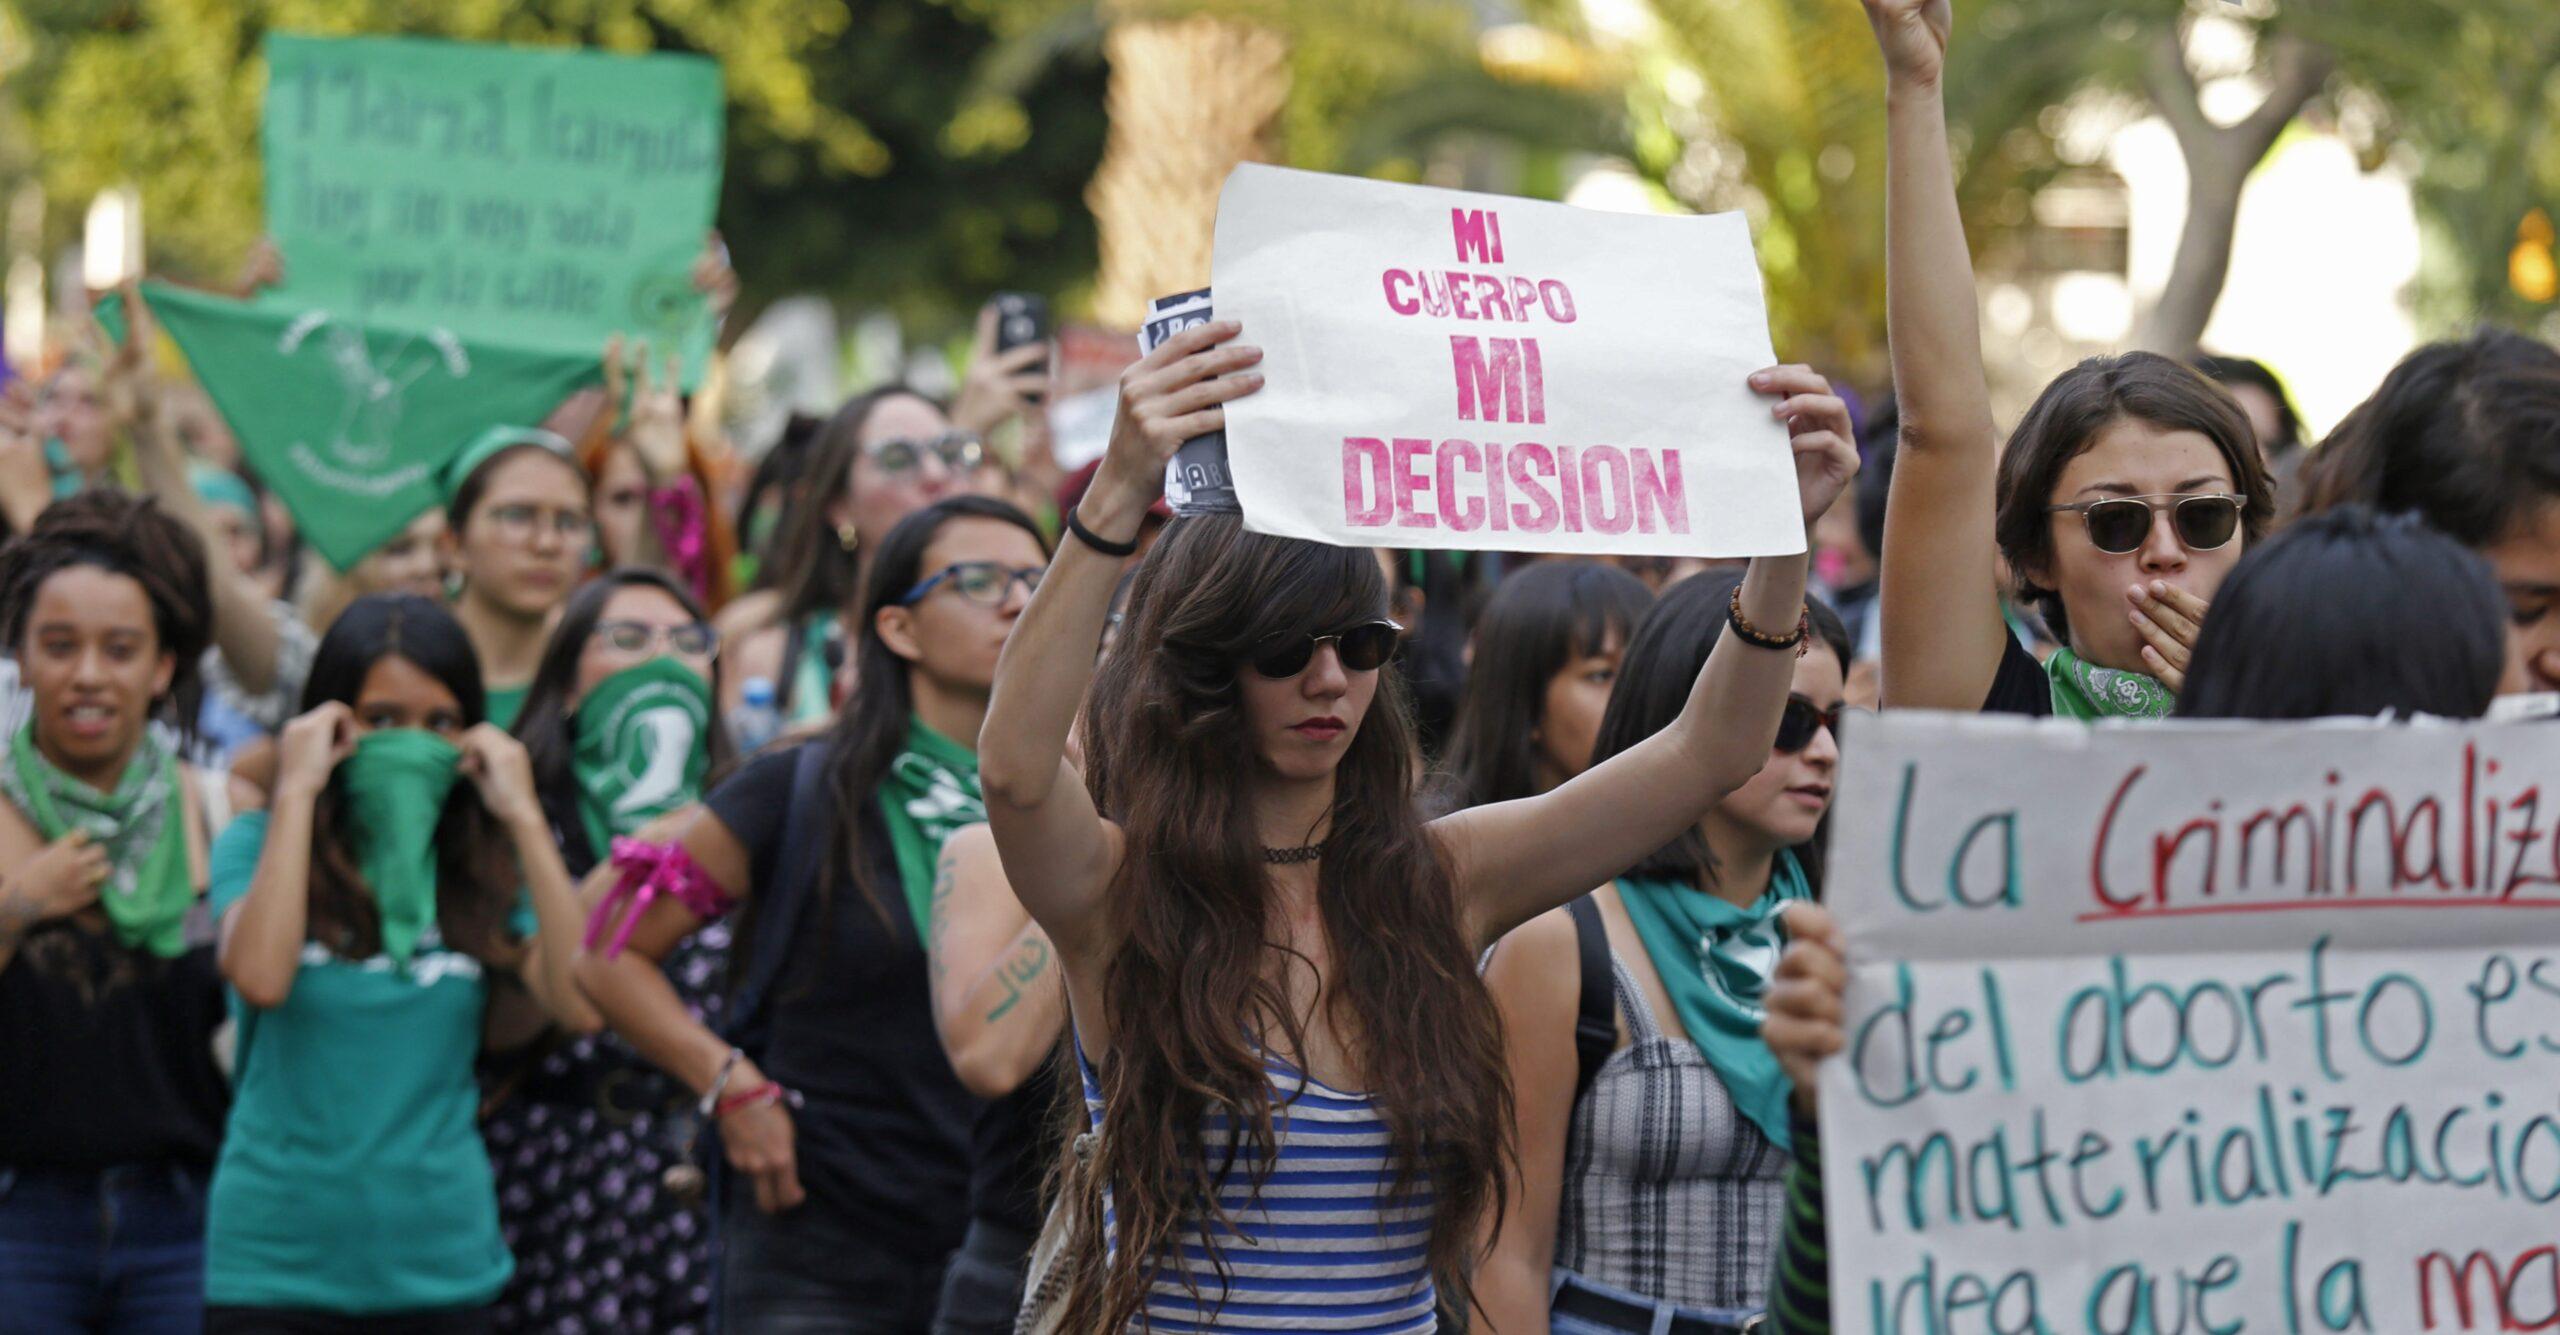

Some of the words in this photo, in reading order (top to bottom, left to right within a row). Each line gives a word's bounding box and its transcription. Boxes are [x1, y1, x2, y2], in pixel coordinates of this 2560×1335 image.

[1451, 207, 1504, 264] MI
[1382, 268, 1577, 324] CUERPO
[1449, 334, 1546, 424] MI
[1342, 436, 1690, 535] DECISION
[2090, 740, 2560, 917] Criminaliz
[1851, 960, 2014, 1109] del
[2058, 934, 2435, 1084] aborto
[1868, 1252, 2055, 1335] idea
[2282, 1219, 2374, 1334] la
